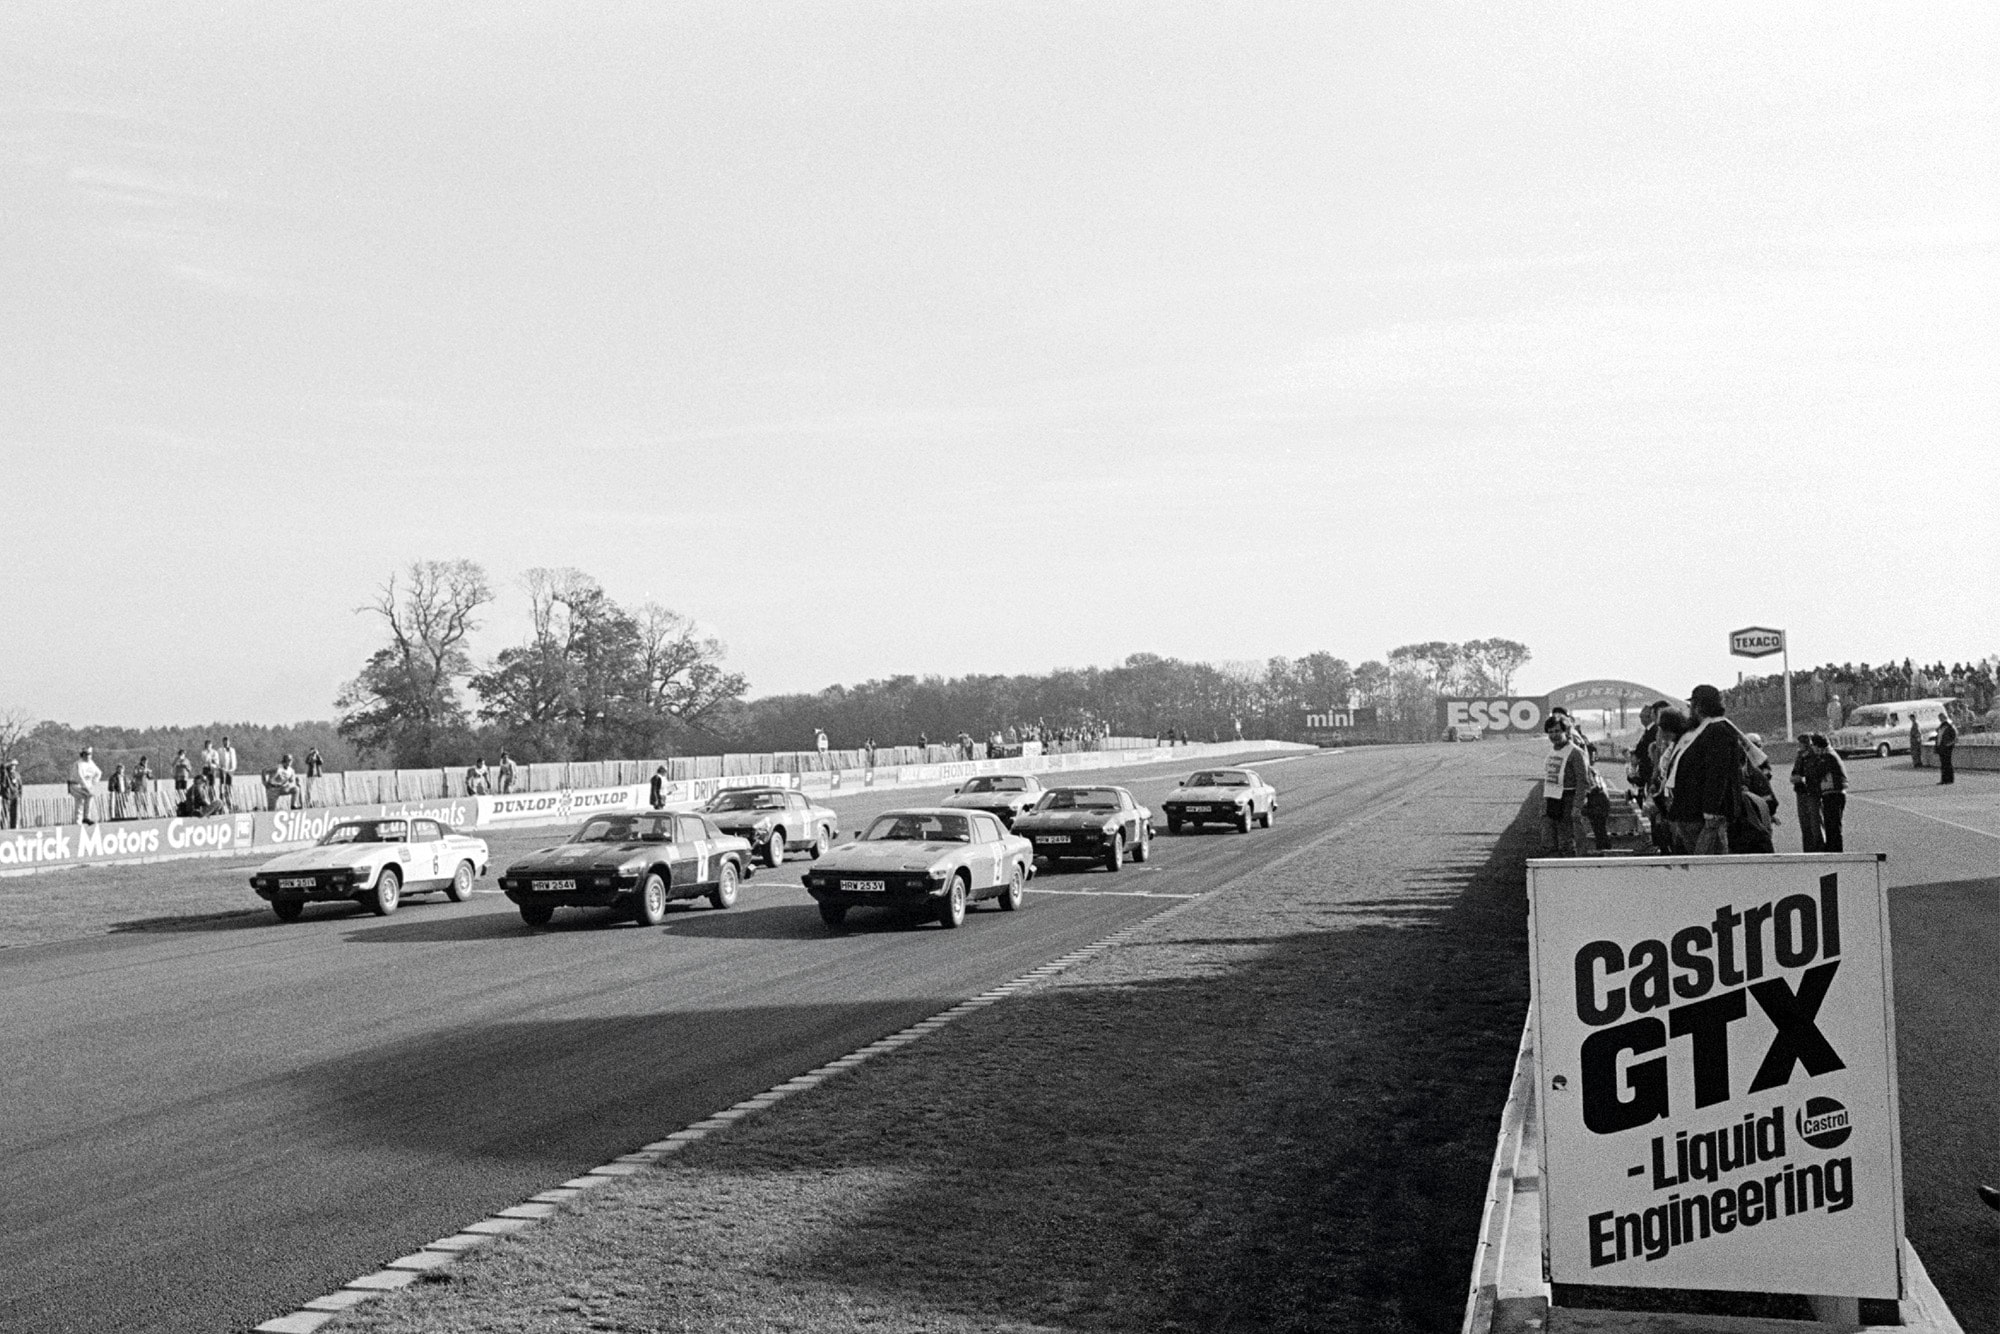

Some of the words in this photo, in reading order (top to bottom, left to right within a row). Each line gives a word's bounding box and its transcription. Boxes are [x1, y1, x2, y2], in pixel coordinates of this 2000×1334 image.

[1735, 636, 1780, 648] TEXACO
[1306, 709, 1354, 727] mini
[1447, 700, 1541, 731] ESSO
[942, 763, 978, 779] HONDA
[694, 780, 719, 801] DRIVE
[492, 798, 557, 814] DUNLOP
[574, 791, 628, 807] DUNLOP
[77, 822, 160, 858] Motors
[167, 817, 232, 850] Group
[433, 855, 439, 875] 6
[532, 881, 550, 889] HRW
[552, 880, 576, 889] 254V
[841, 881, 858, 890] HRW
[860, 881, 884, 890] 253V
[1574, 872, 1841, 1026] Castrol
[1580, 959, 1847, 1134] GTX
[1803, 1111, 1849, 1135] Castrol
[1588, 1156, 1853, 1268] Engineering
